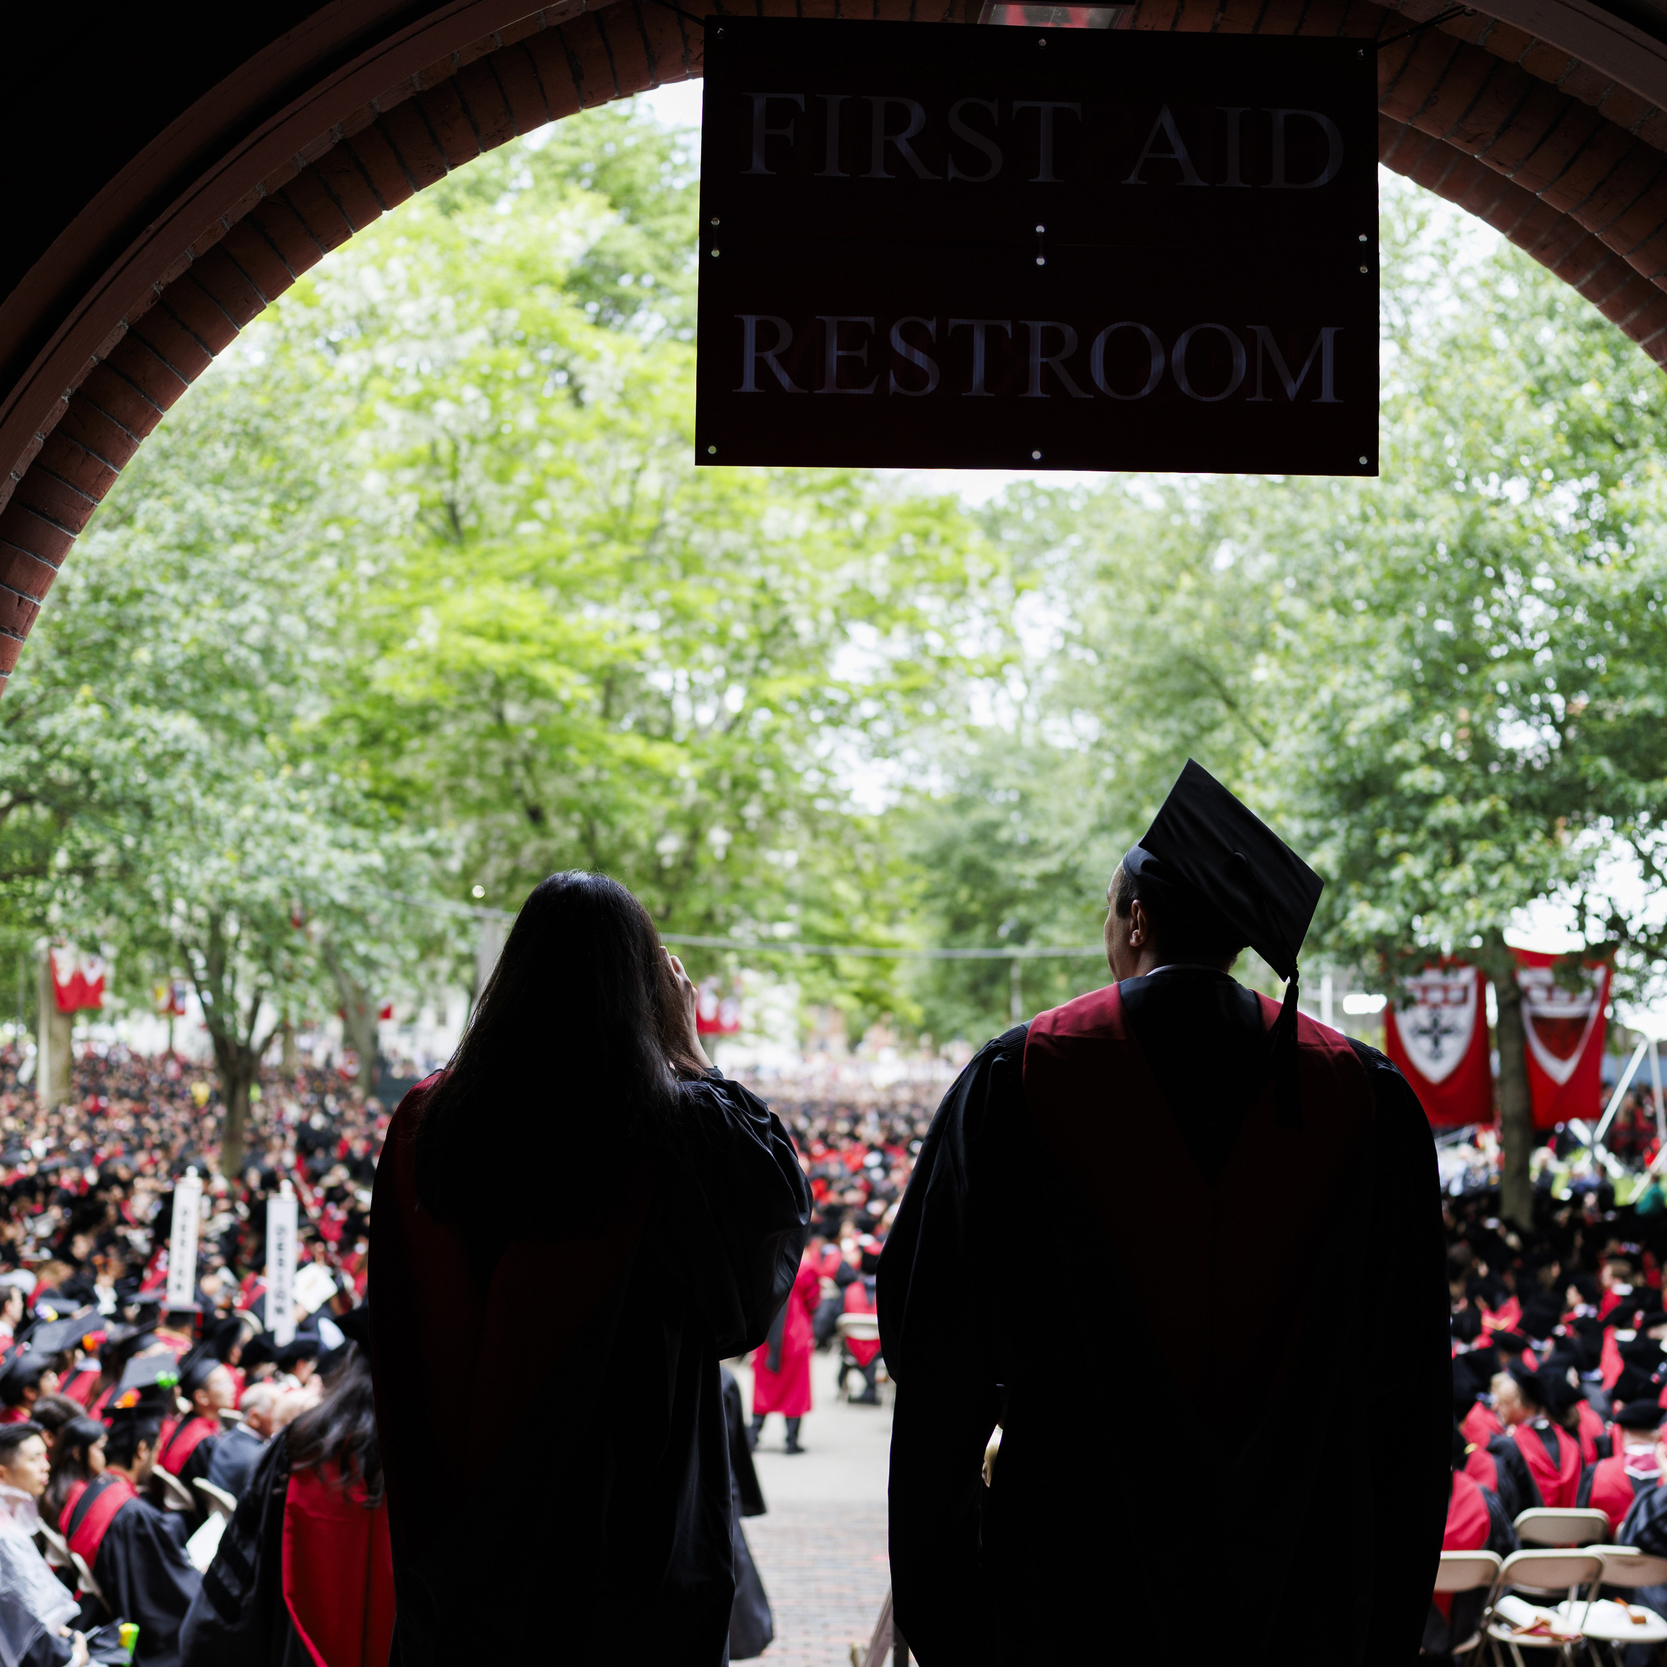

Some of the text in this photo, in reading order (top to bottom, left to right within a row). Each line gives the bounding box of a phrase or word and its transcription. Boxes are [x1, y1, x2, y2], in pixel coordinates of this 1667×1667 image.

[739, 91, 1345, 190] FIRST AID
[731, 313, 1345, 405] RESTROOM
